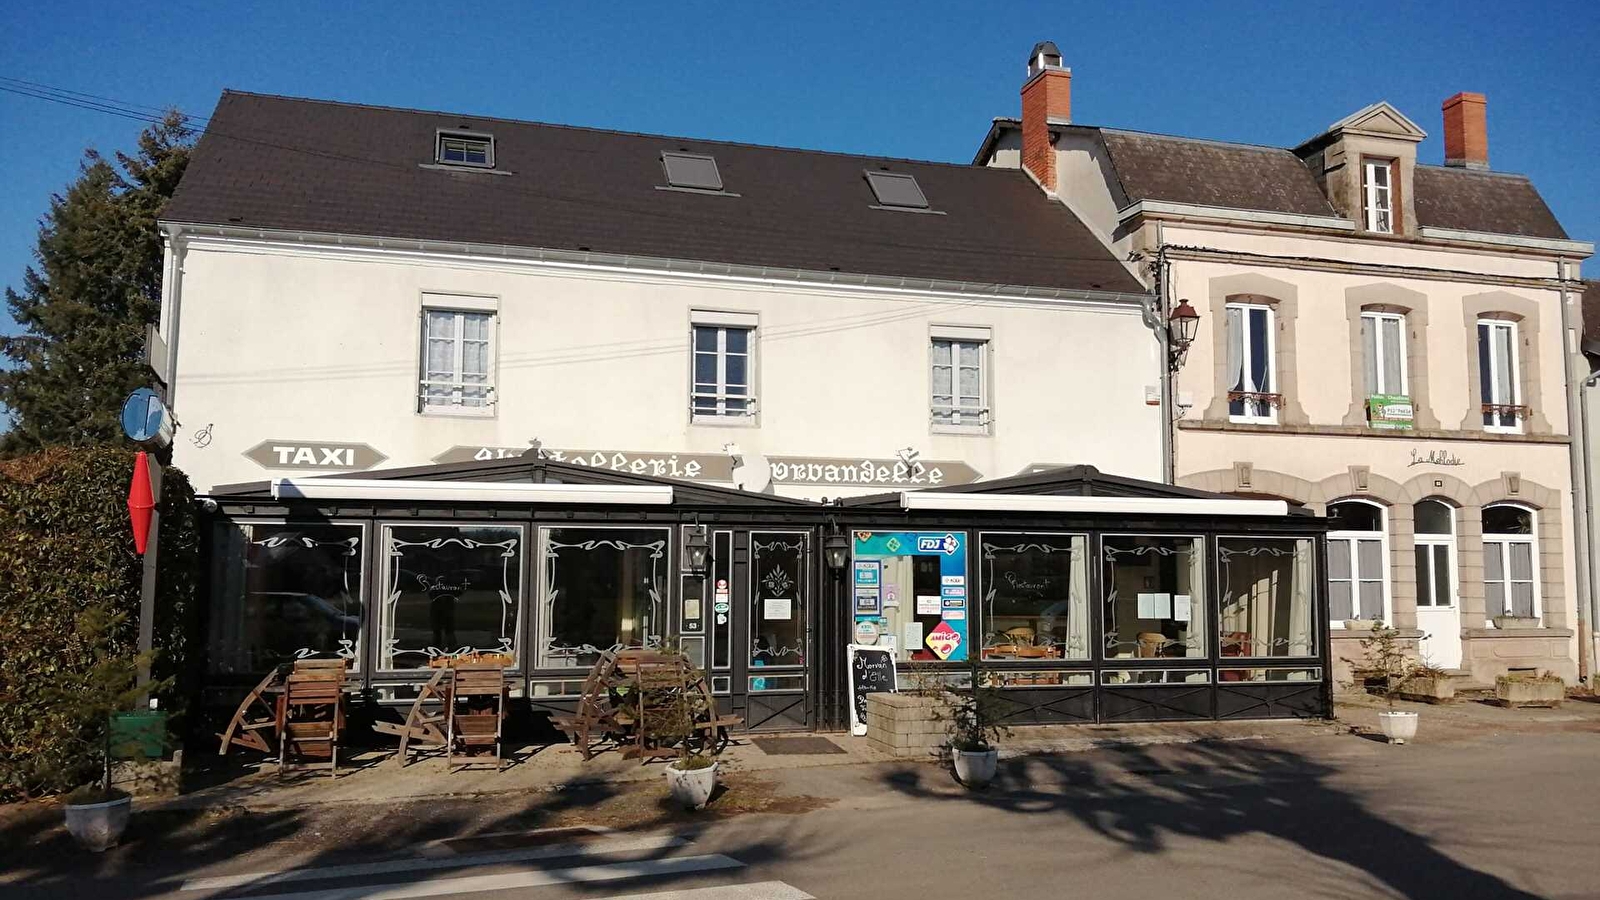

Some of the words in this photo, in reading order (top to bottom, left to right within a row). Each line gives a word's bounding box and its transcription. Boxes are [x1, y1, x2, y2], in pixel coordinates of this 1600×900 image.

[272, 446, 354, 466] TAXI
[770, 459, 943, 484] orvandelle
[921, 539, 941, 549] FDJ
[856, 656, 887, 670] Morvan
